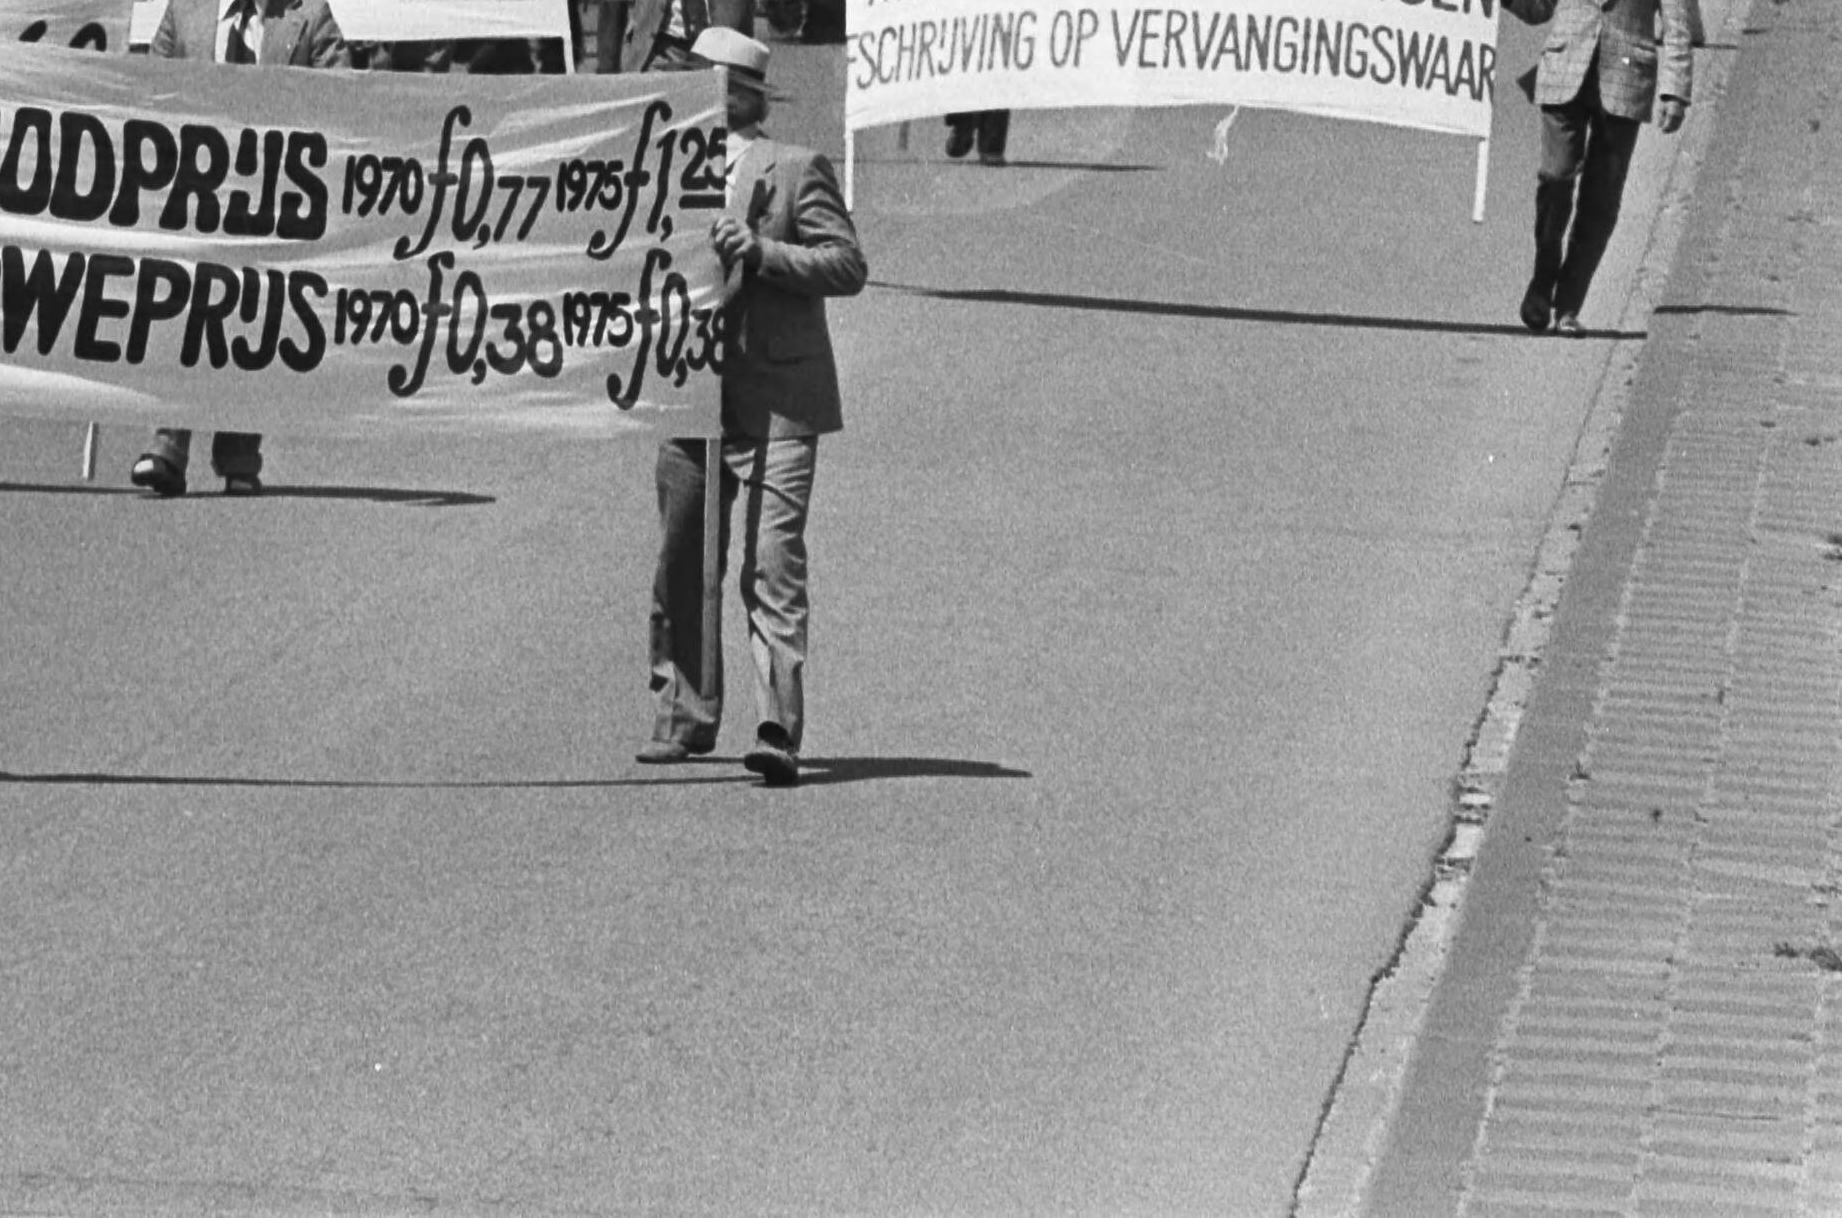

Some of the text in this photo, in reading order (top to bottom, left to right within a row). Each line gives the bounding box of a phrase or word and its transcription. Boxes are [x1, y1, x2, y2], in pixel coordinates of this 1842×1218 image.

[1050, 9, 1099, 66] OP
[1111, 8, 1497, 101] VERVANGINGSWAAR
[342, 154, 424, 217] 1970
[556, 159, 624, 212] 1975
[334, 287, 420, 345] 1970
[563, 292, 634, 347] 1975
